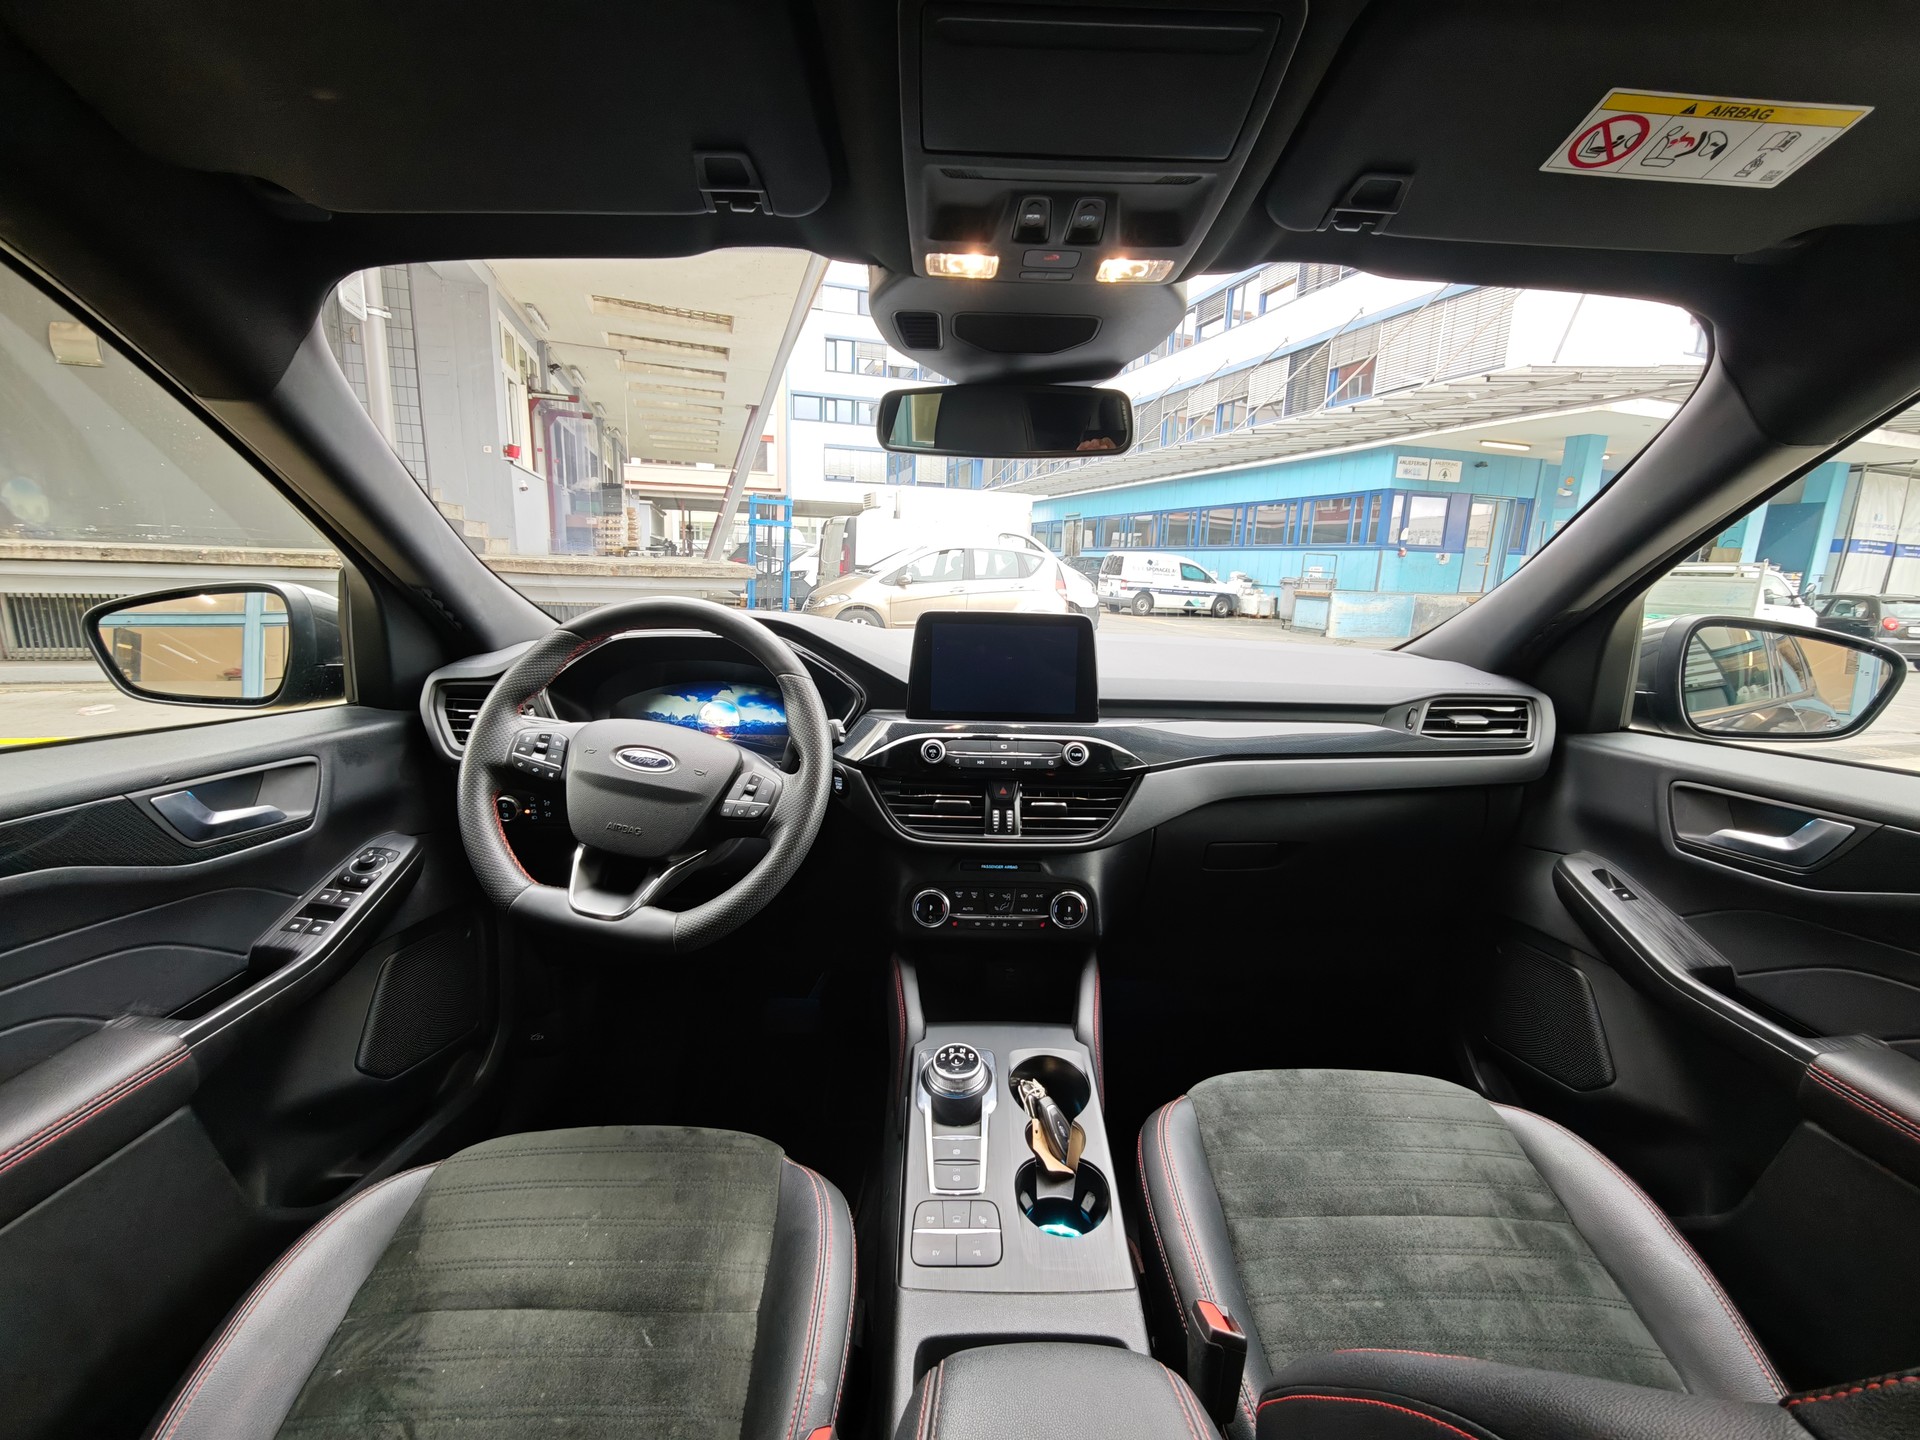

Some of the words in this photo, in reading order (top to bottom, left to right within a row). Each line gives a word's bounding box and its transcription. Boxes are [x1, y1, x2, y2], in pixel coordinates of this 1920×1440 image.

[1705, 105, 1775, 120] AIRBAG
[629, 752, 663, 768] Ford
[606, 821, 642, 836] AIRBAG
